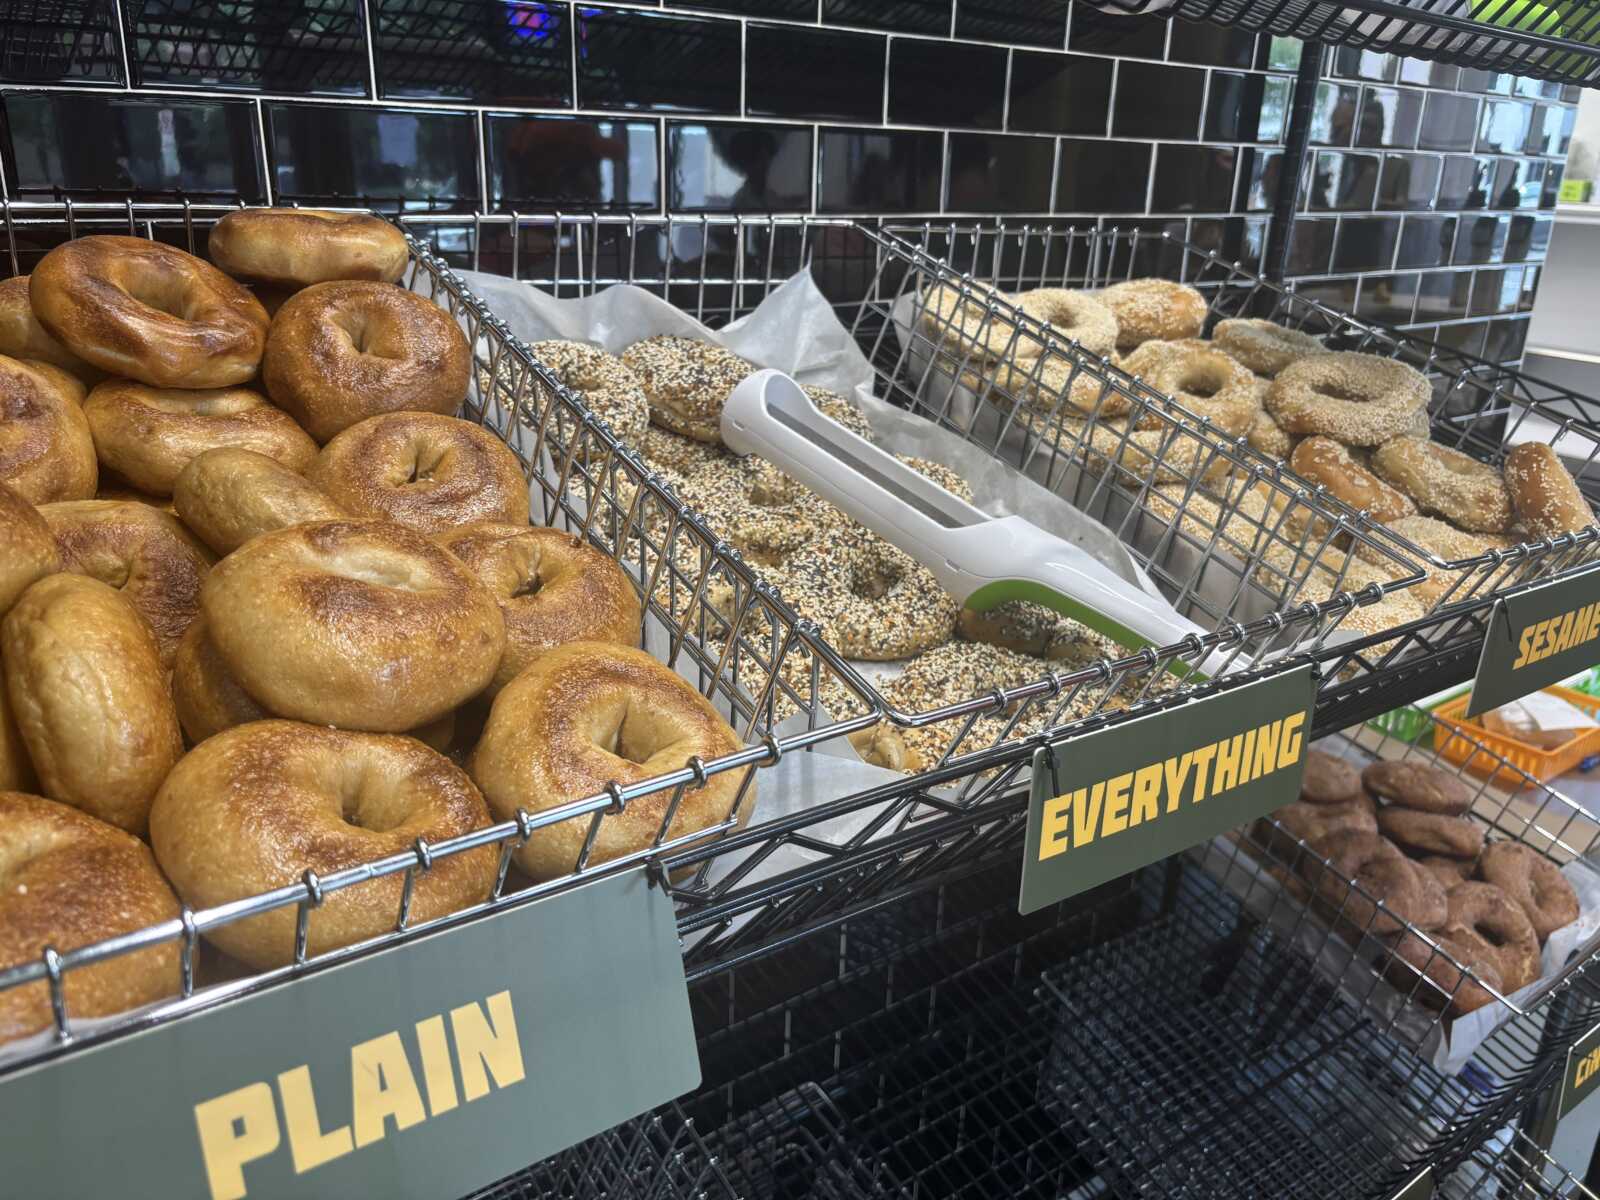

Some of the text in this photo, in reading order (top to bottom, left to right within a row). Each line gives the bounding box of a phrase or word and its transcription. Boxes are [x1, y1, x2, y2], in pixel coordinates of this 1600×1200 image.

[1512, 601, 1600, 670] SESAME
[1039, 711, 1306, 862] EVERYTHING
[195, 990, 525, 1200] PLAIN
